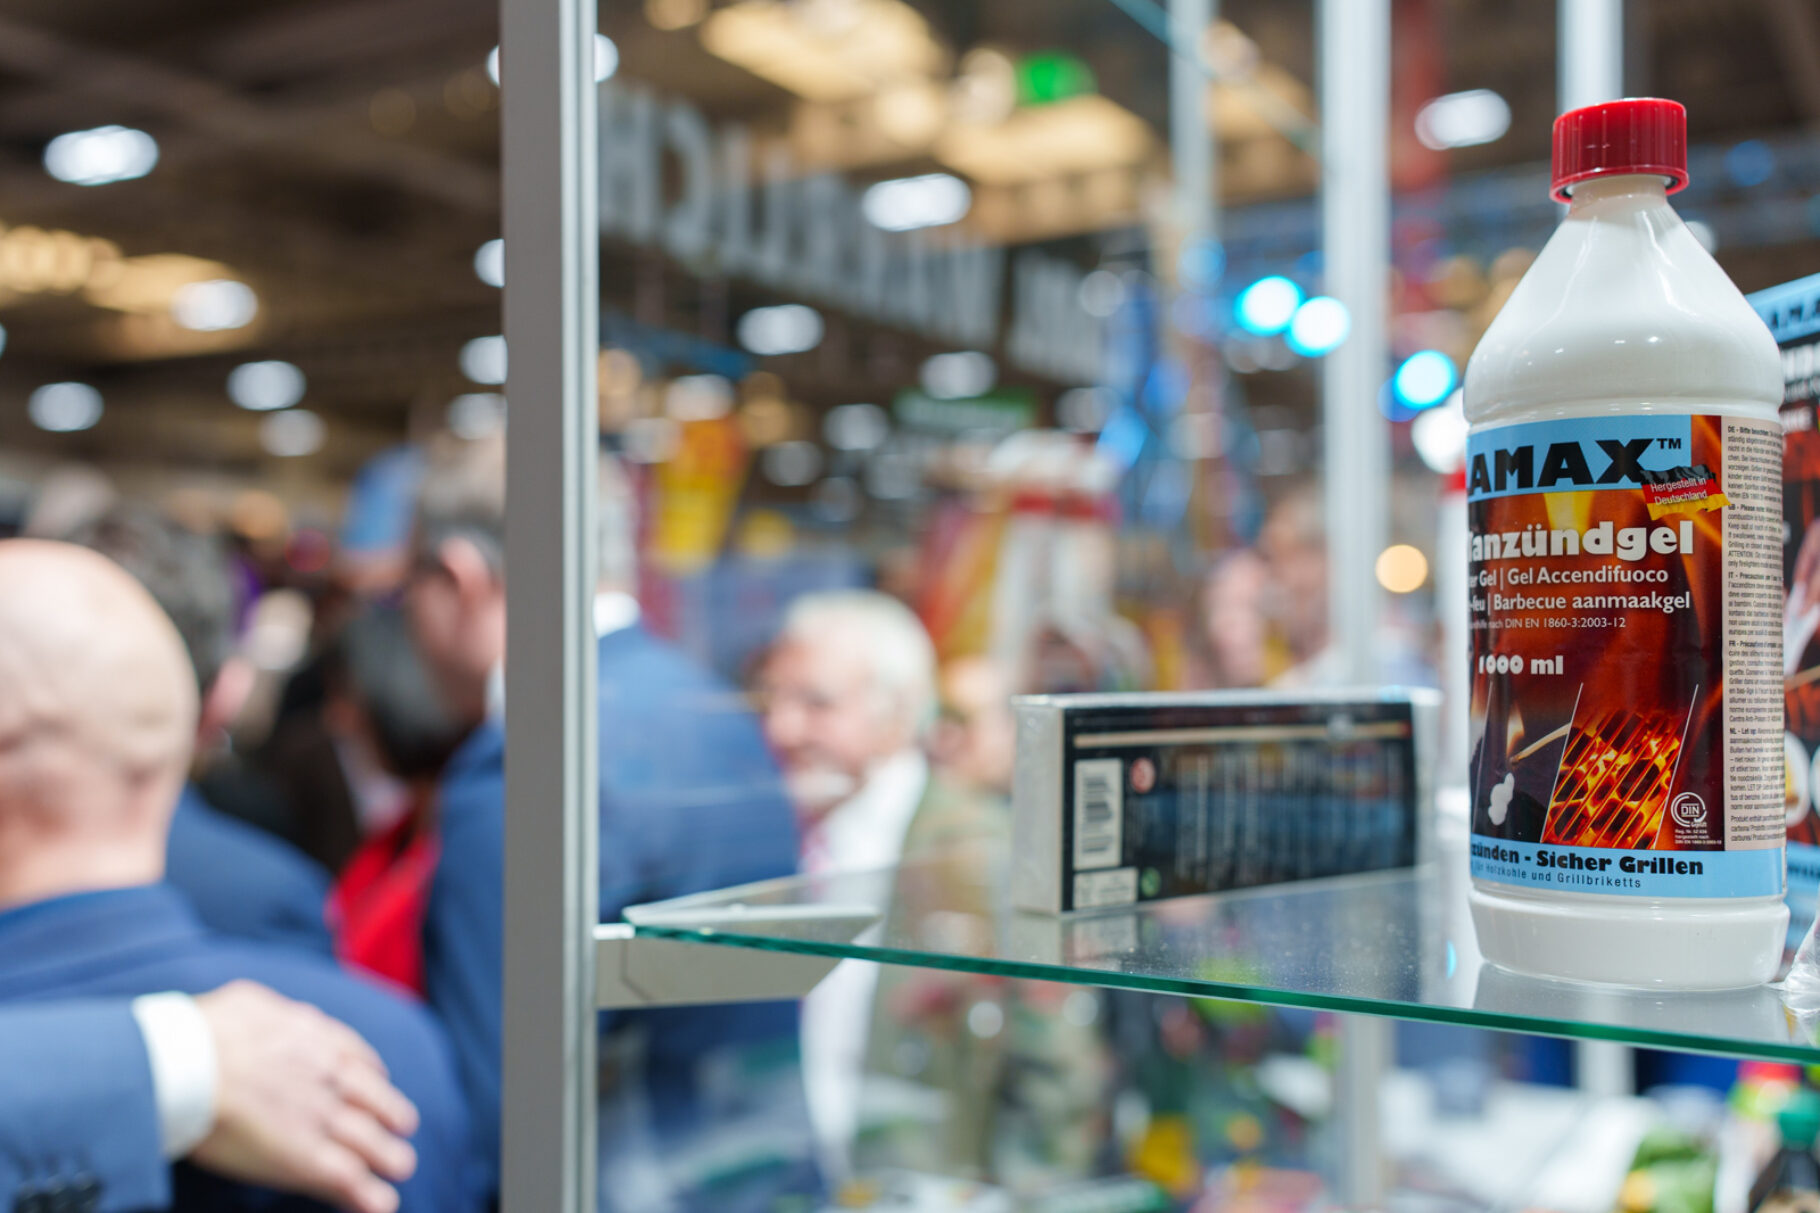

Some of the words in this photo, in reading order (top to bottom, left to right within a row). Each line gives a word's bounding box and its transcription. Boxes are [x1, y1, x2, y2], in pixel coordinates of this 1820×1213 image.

[1650, 479, 1697, 493] Hergestellt
[1697, 477, 1707, 486] in
[1654, 490, 1708, 505] Deutschland
[1479, 569, 1497, 587] Gel
[1507, 567, 1533, 585] Gel
[1536, 564, 1669, 584] Accendifuoco
[1493, 593, 1567, 611] Barbecue
[1572, 591, 1691, 614] aanmaakgel
[1504, 618, 1523, 628] DIN
[1525, 617, 1540, 628] EN
[1543, 617, 1627, 628] 1860-3:2003-12
[1479, 654, 1524, 675] 1000
[1530, 655, 1564, 675] ml
[1536, 850, 1612, 872] Sicher
[1619, 856, 1704, 875] Grillen
[1531, 872, 1551, 882] und
[1557, 872, 1641, 888] Grillbriketts
